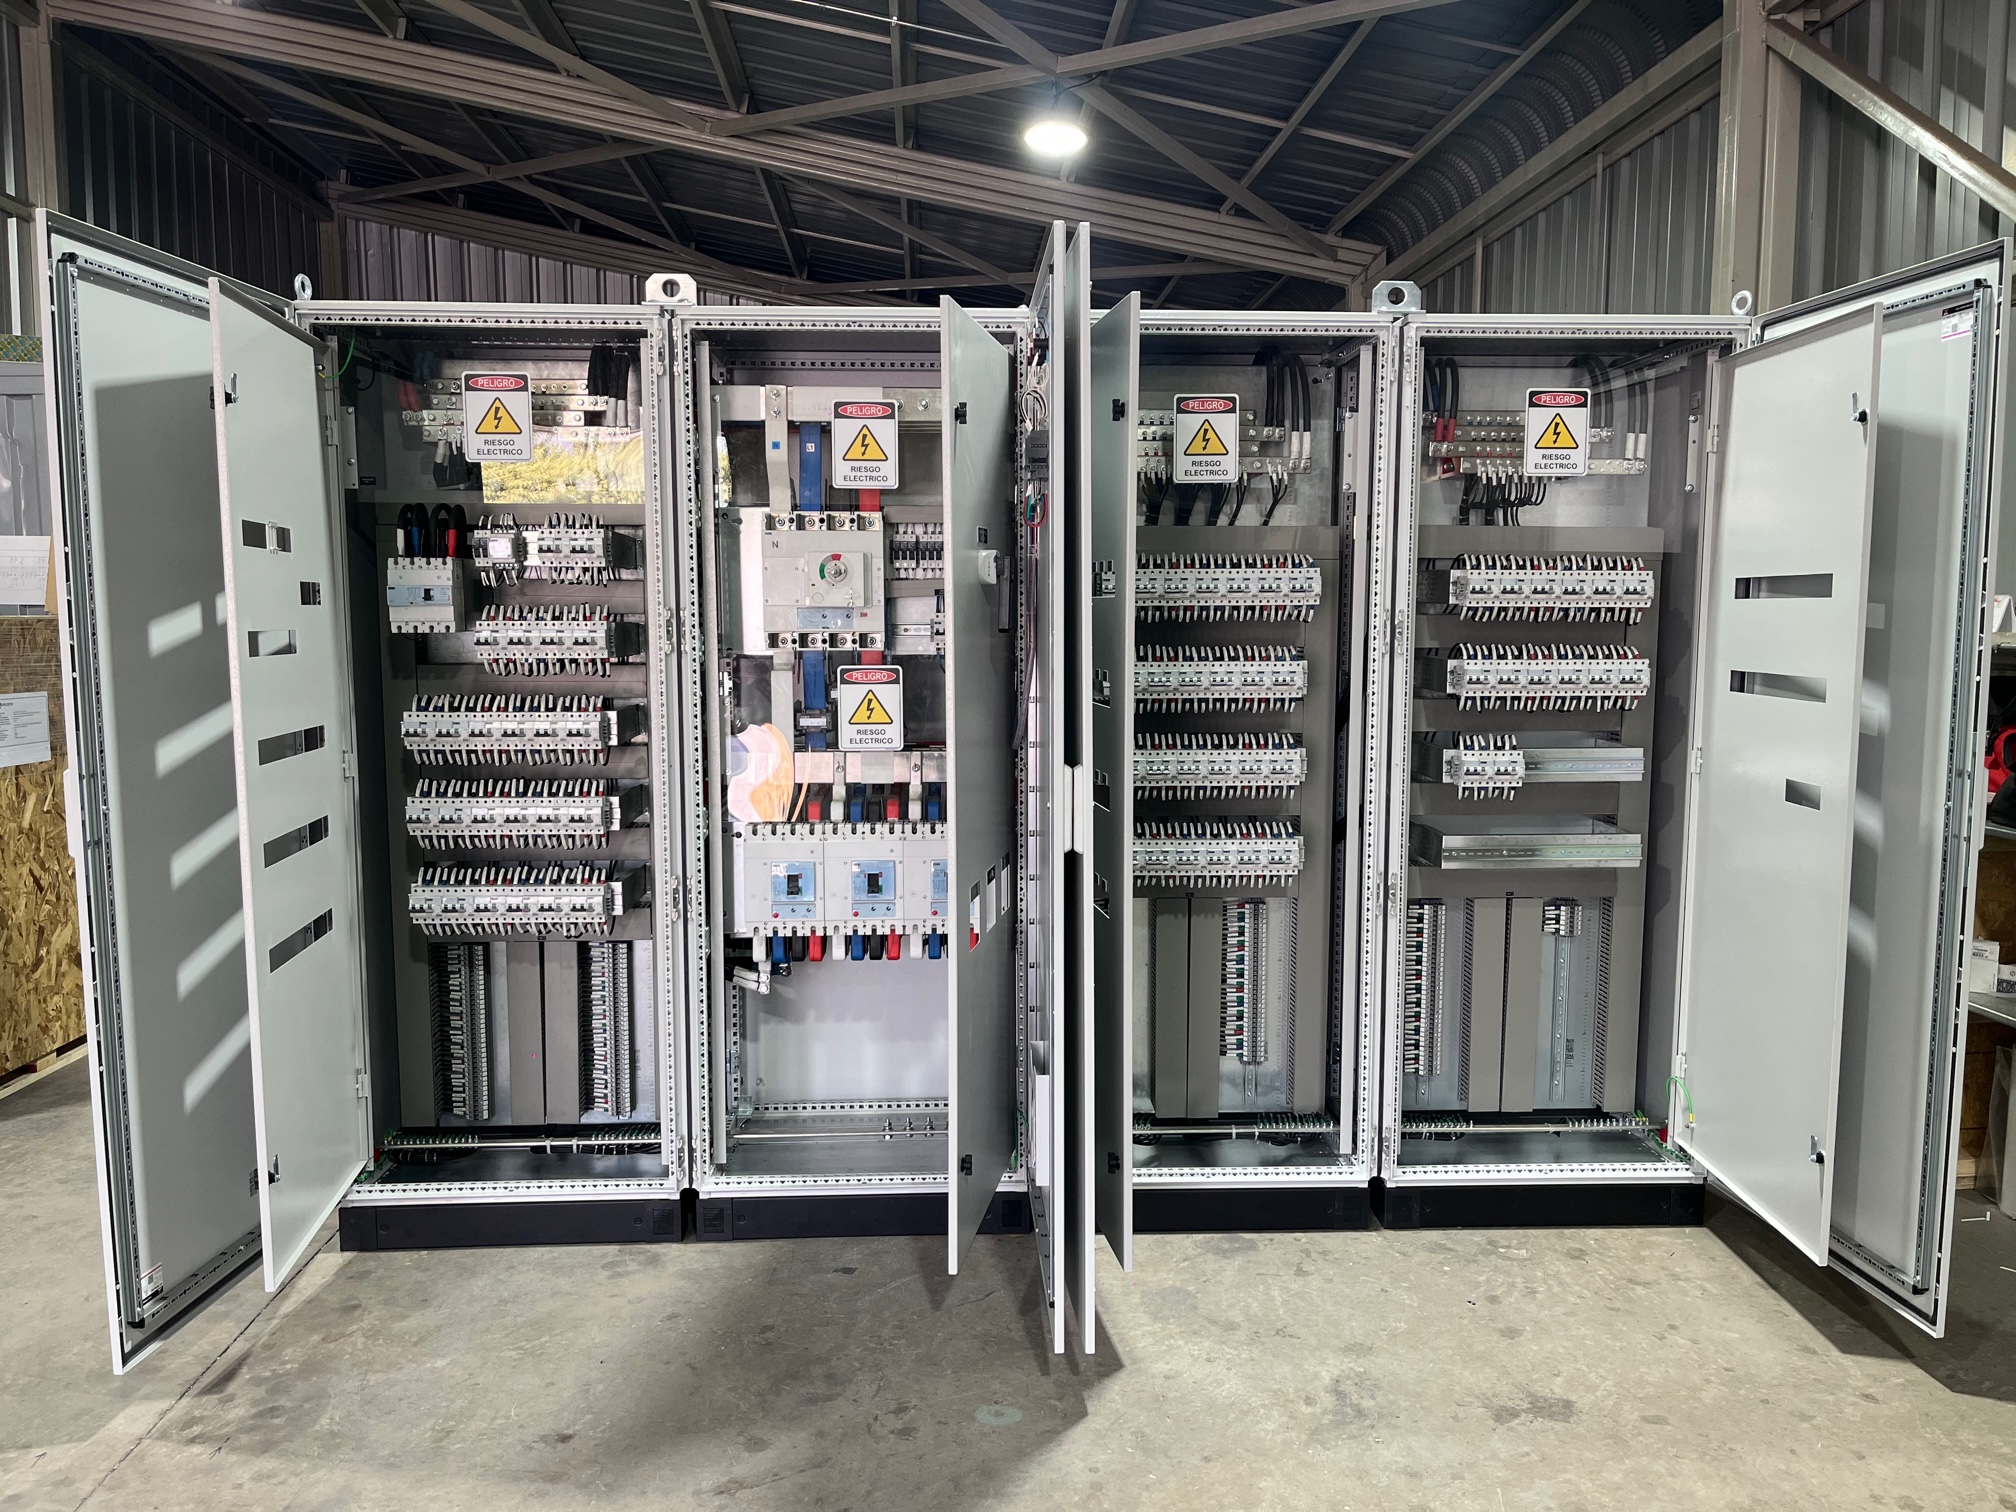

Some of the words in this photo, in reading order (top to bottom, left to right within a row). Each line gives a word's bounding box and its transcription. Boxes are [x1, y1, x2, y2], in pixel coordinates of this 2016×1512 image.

[477, 378, 516, 388] PELIGRO
[1189, 400, 1225, 410] PELIGRO
[1541, 395, 1576, 405] PELIGRO
[847, 405, 884, 415] PELIGRO
[477, 448, 523, 456] ELECTRICO
[772, 540, 779, 549] N
[852, 671, 888, 681] PELIGRO
[849, 737, 893, 745] ELECTRICO
